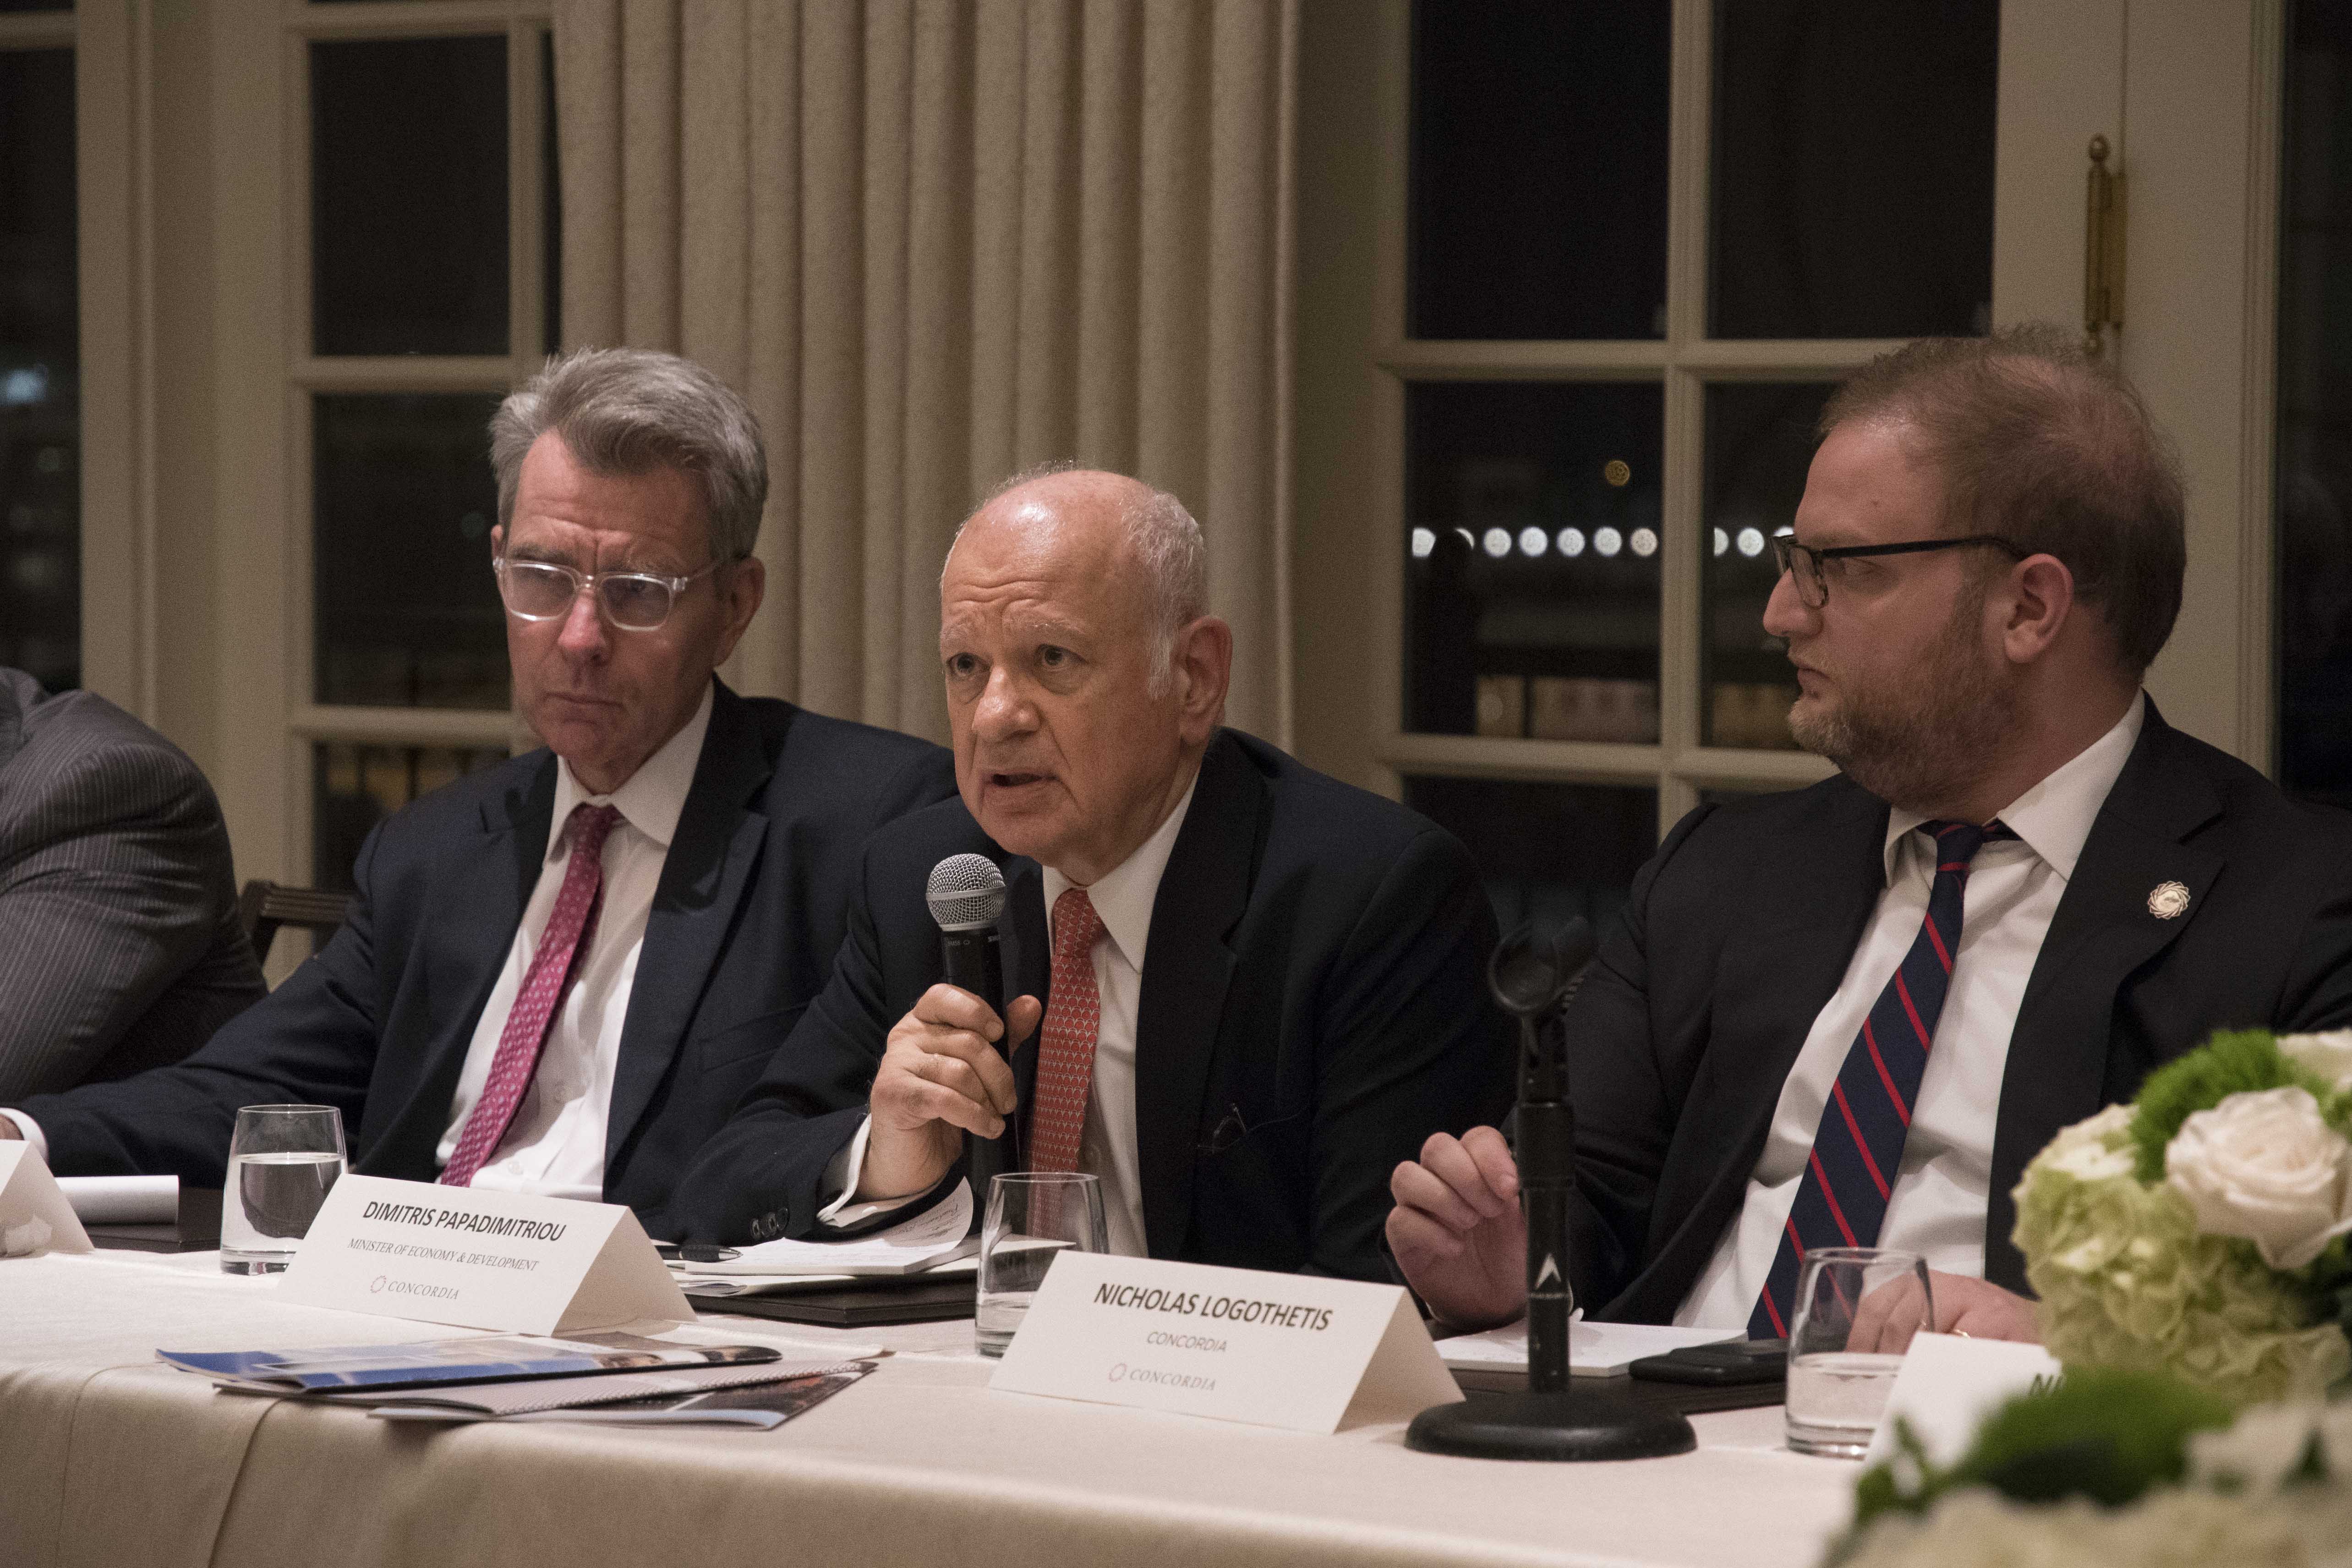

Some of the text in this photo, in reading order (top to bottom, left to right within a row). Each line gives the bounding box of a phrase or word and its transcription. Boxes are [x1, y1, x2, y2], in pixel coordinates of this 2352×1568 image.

[363, 1201, 567, 1241] DIMITRIS PAPADIMITRIOU
[347, 1238, 539, 1271] MINISTER OF ECONOMY & DEVELOPMENT
[388, 1281, 459, 1299] CONCORDIA
[1094, 1283, 1333, 1330] NICHOLAS LOGOTHETIS
[1147, 1331, 1227, 1351] CONCORDIA
[1130, 1369, 1216, 1390] CONCORDIA
